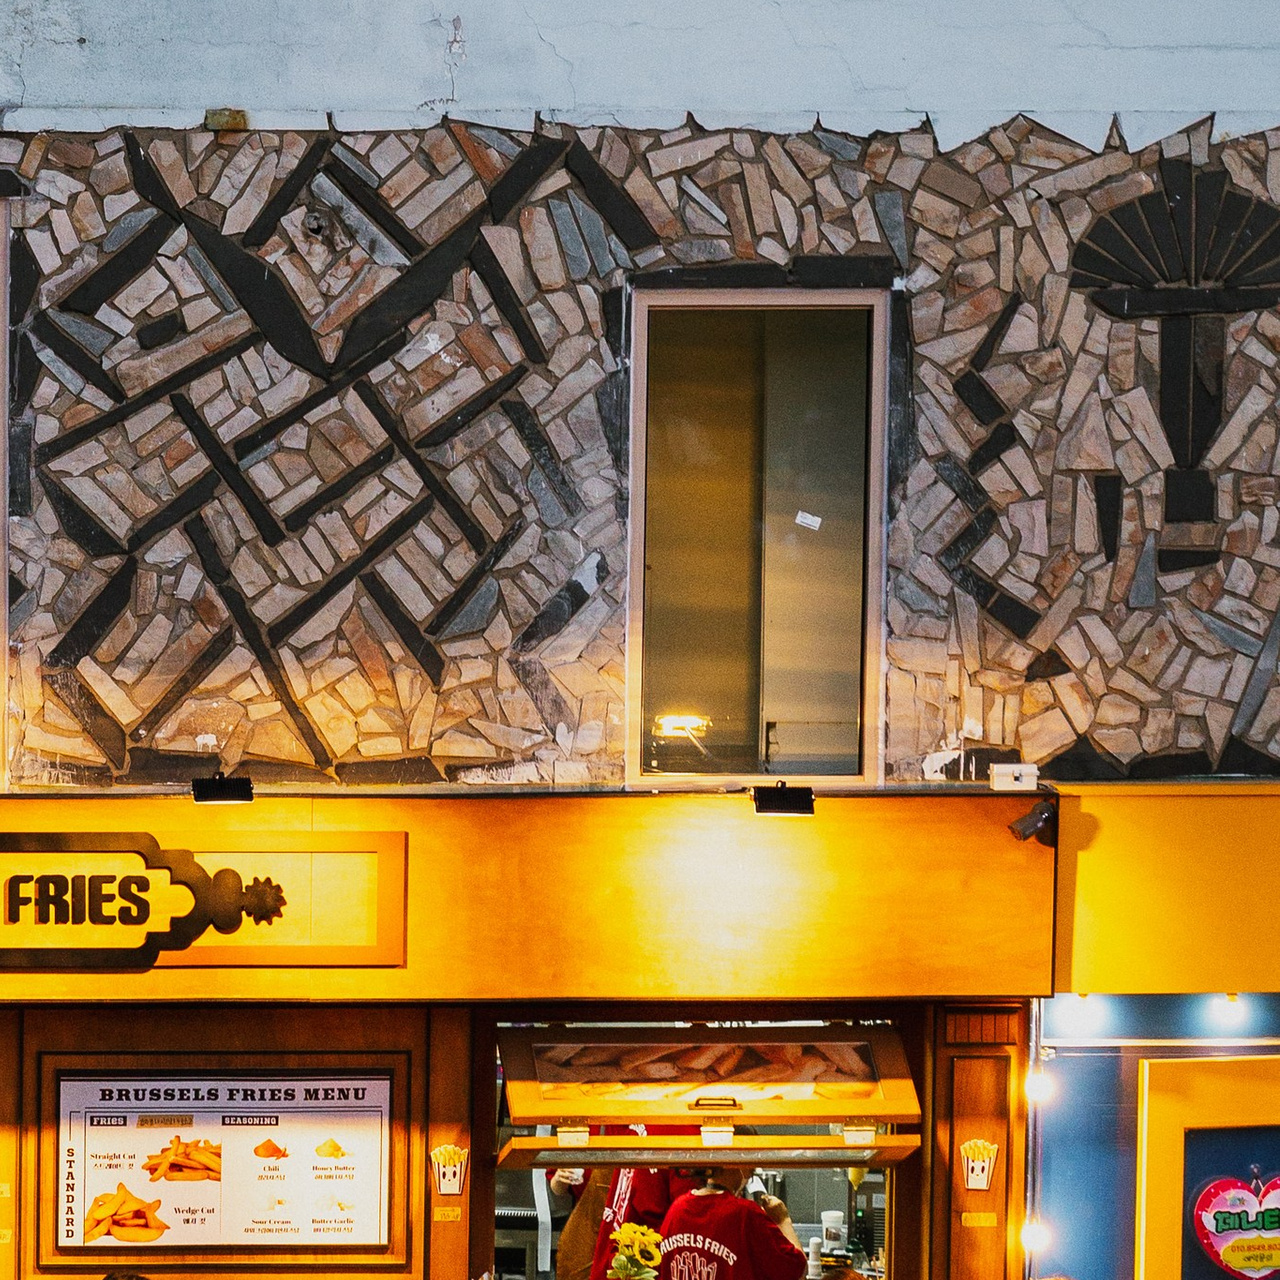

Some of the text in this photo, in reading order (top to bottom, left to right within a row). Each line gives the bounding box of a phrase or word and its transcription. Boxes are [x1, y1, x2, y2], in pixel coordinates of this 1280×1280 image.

[8, 874, 151, 926] FRIES
[99, 1087, 368, 1101] BRUSSELS FRIES MENU
[92, 1116, 124, 1125] FRIES
[224, 1116, 277, 1125] SEASONING
[90, 1153, 121, 1162] Straight
[65, 1147, 75, 1239] STANDARD
[174, 1207, 200, 1215] Wedge
[660, 1233, 738, 1266] RUSSELS FRIES
